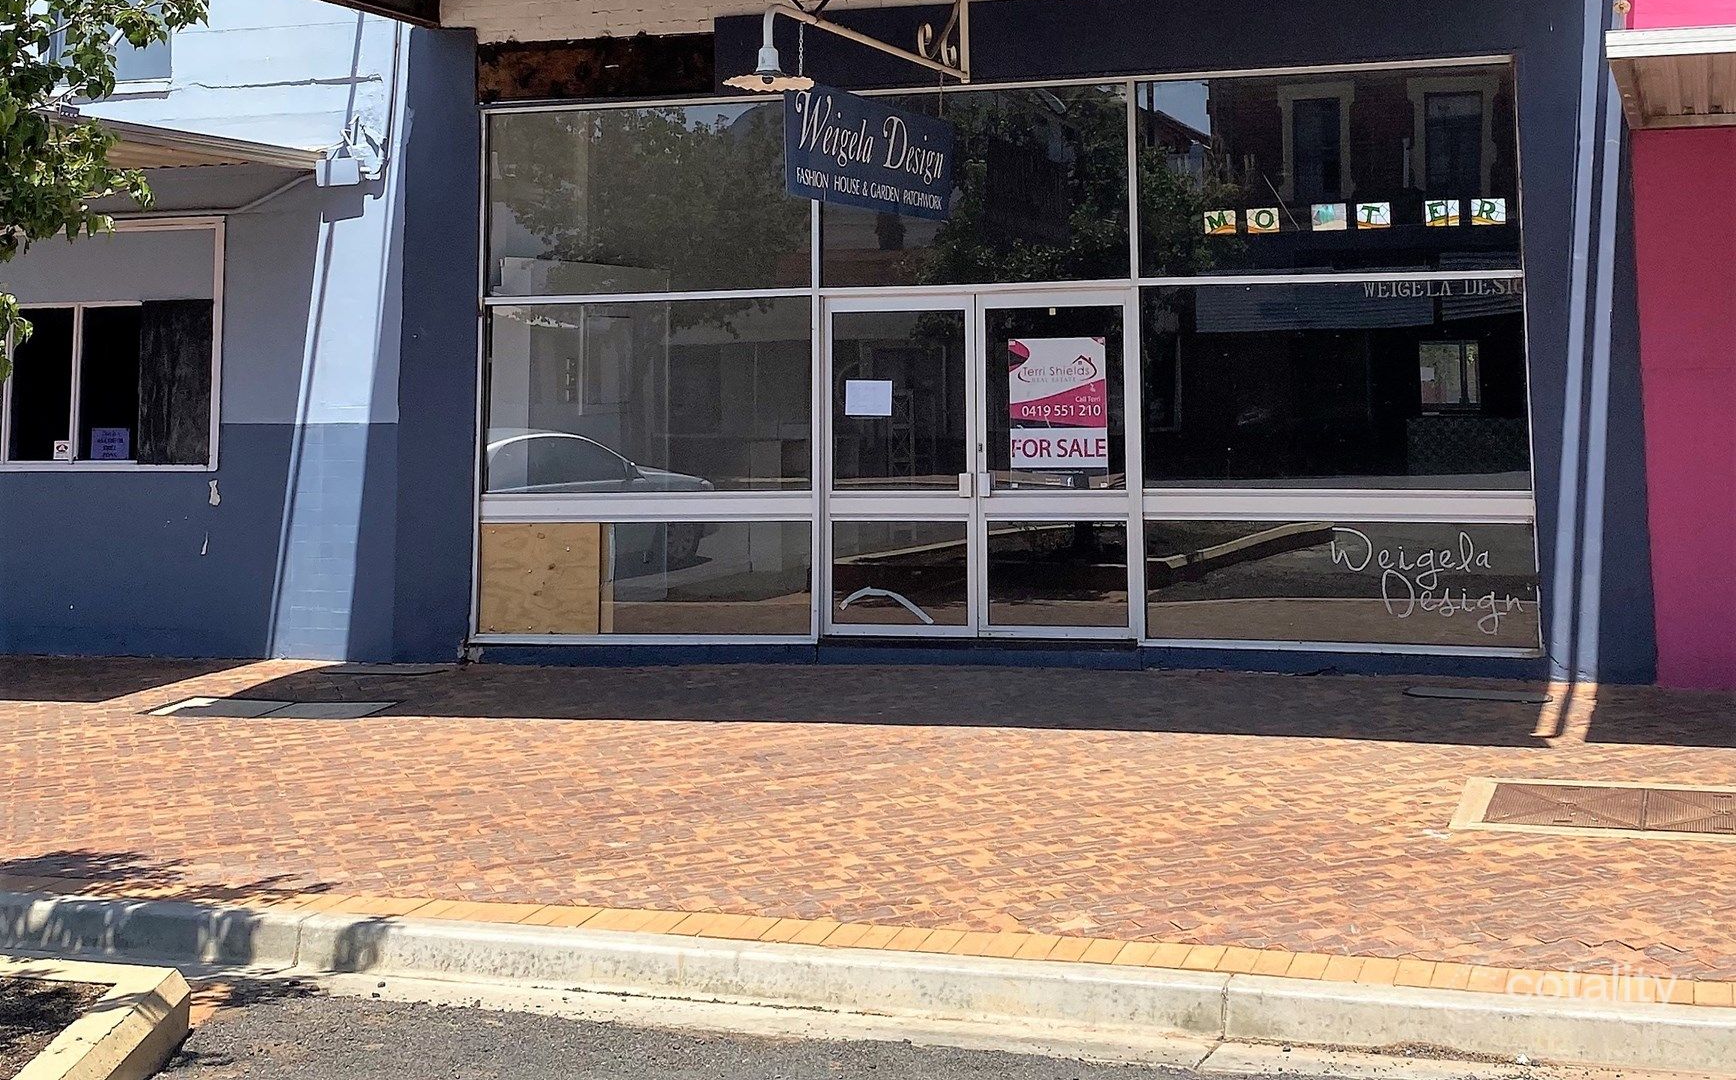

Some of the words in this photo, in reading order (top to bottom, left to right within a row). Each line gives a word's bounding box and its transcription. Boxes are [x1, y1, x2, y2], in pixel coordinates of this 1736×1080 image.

[795, 90, 875, 168] Weigela
[882, 115, 945, 186] Design
[796, 166, 830, 189] FASHION
[834, 174, 861, 197] HOUSE
[862, 181, 869, 197] &
[869, 182, 900, 203] GARDEN
[903, 189, 943, 211] PATCHWORK
[1363, 280, 1454, 299] WEIGELA
[1022, 366, 1046, 377] Terri
[1049, 366, 1090, 377] Shields
[1075, 395, 1087, 403] Call
[1021, 405, 1052, 417] 0419
[1053, 405, 1074, 416] 551
[1078, 404, 1101, 416] 210
[1011, 438, 1052, 458] FOR
[1056, 438, 1107, 458] SALE
[1331, 526, 1492, 591] Weigela
[1381, 569, 1524, 636] Design
